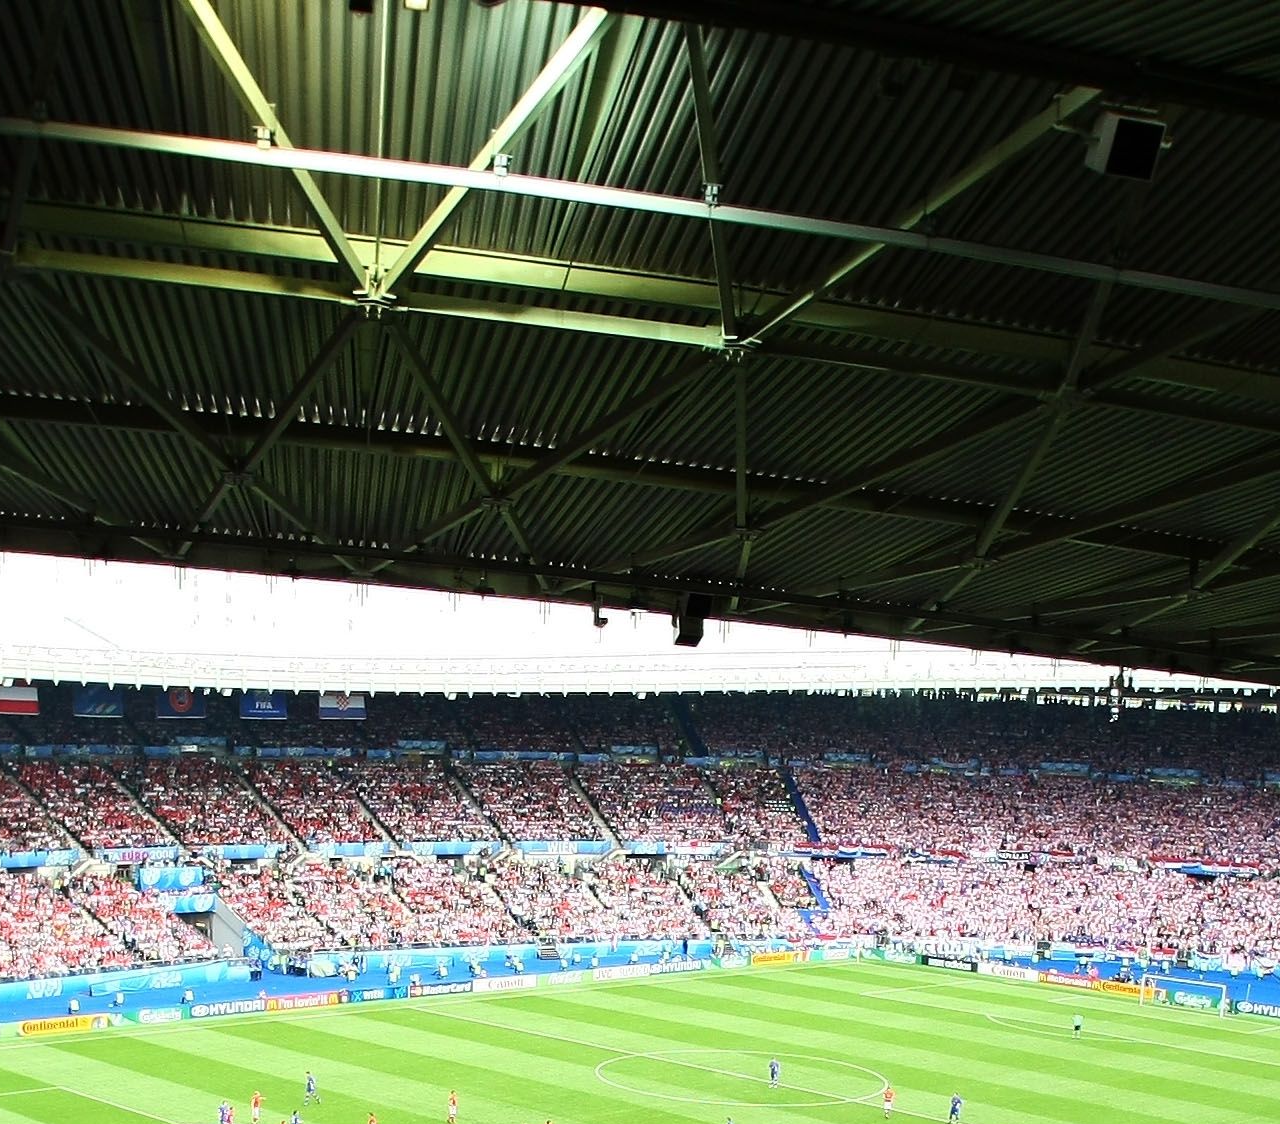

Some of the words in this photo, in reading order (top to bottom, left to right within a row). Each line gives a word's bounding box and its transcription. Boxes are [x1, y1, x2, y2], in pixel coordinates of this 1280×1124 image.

[255, 701, 273, 710] FIFA
[548, 841, 577, 853] WIEN
[122, 850, 148, 861] EURO
[992, 965, 1026, 979] Canon
[488, 977, 524, 990] Canon
[209, 999, 265, 1016] HYUNDAI
[22, 1018, 79, 1035] Continental
